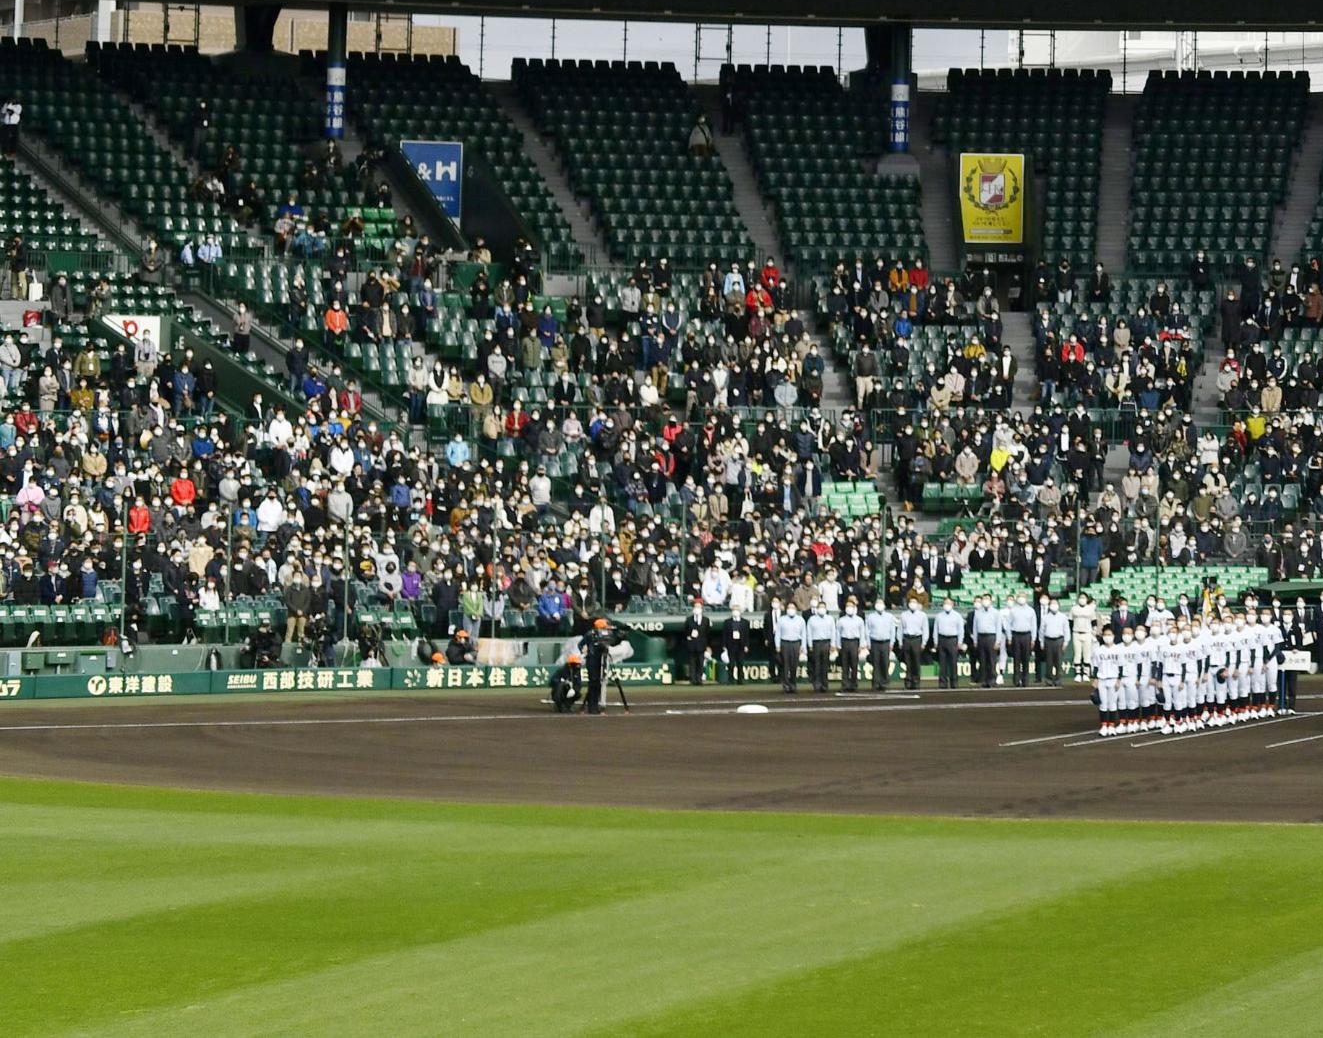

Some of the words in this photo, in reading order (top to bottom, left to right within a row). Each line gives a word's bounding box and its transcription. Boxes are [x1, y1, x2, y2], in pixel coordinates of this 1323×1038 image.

[108, 675, 173, 694] 東洋建設
[228, 674, 257, 685] SEIBU
[263, 670, 374, 690] 西部技研工業
[426, 666, 528, 687] 新日本住設
